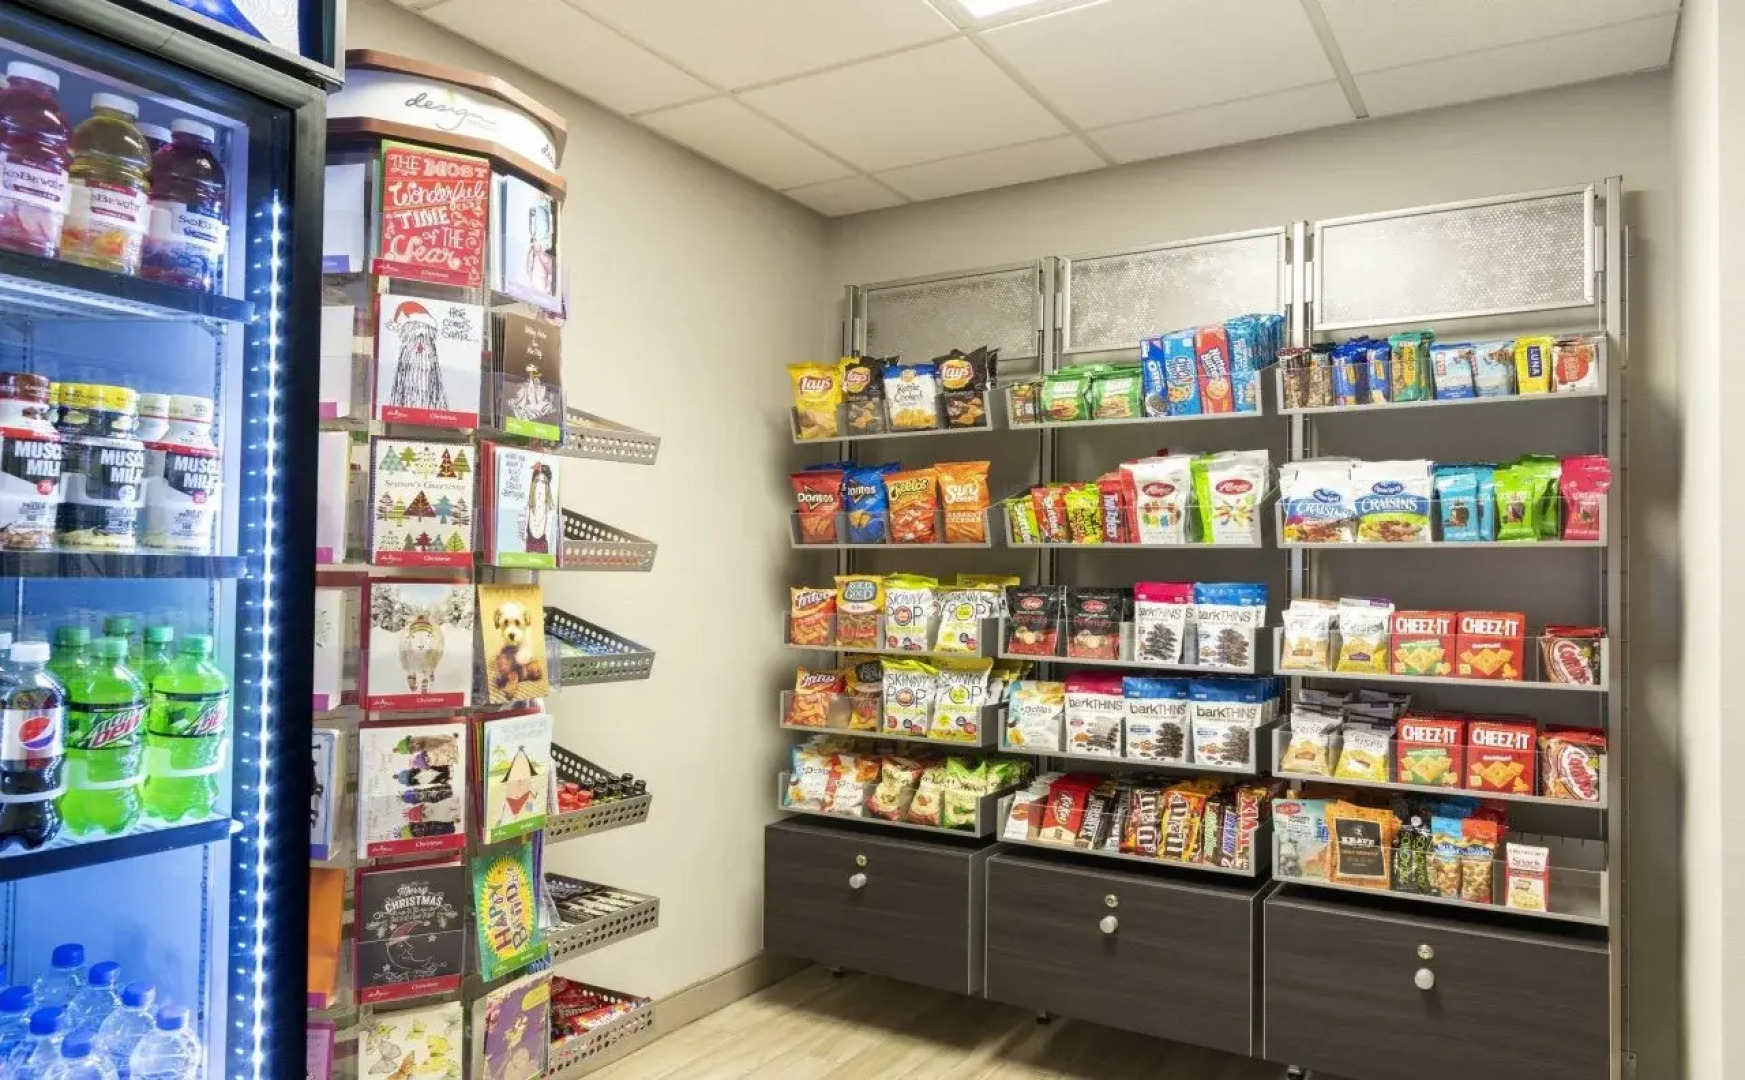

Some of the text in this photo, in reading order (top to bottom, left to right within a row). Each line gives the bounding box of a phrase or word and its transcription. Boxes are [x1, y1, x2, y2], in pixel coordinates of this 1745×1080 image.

[388, 154, 488, 178] THE MOST
[388, 180, 485, 209] Wonderful
[394, 206, 451, 229] TIME
[441, 227, 464, 249] THE
[1528, 349, 1536, 372] LUNA
[797, 493, 834, 502] Doritos
[888, 478, 929, 501] Cheetos
[1362, 498, 1418, 512] CRAISINS
[1395, 617, 1450, 635] CHEEZ-IT
[1461, 617, 1520, 636] CHEEZ-IT
[1069, 698, 1122, 710] barkTHINS
[1129, 702, 1186, 715] barkTHINS
[1197, 706, 1257, 719] barkTHINS
[1402, 725, 1457, 743] CHEEZ-IT
[1472, 728, 1530, 749] CHEEZ-IT
[385, 896, 444, 913] CHRISTMAS
